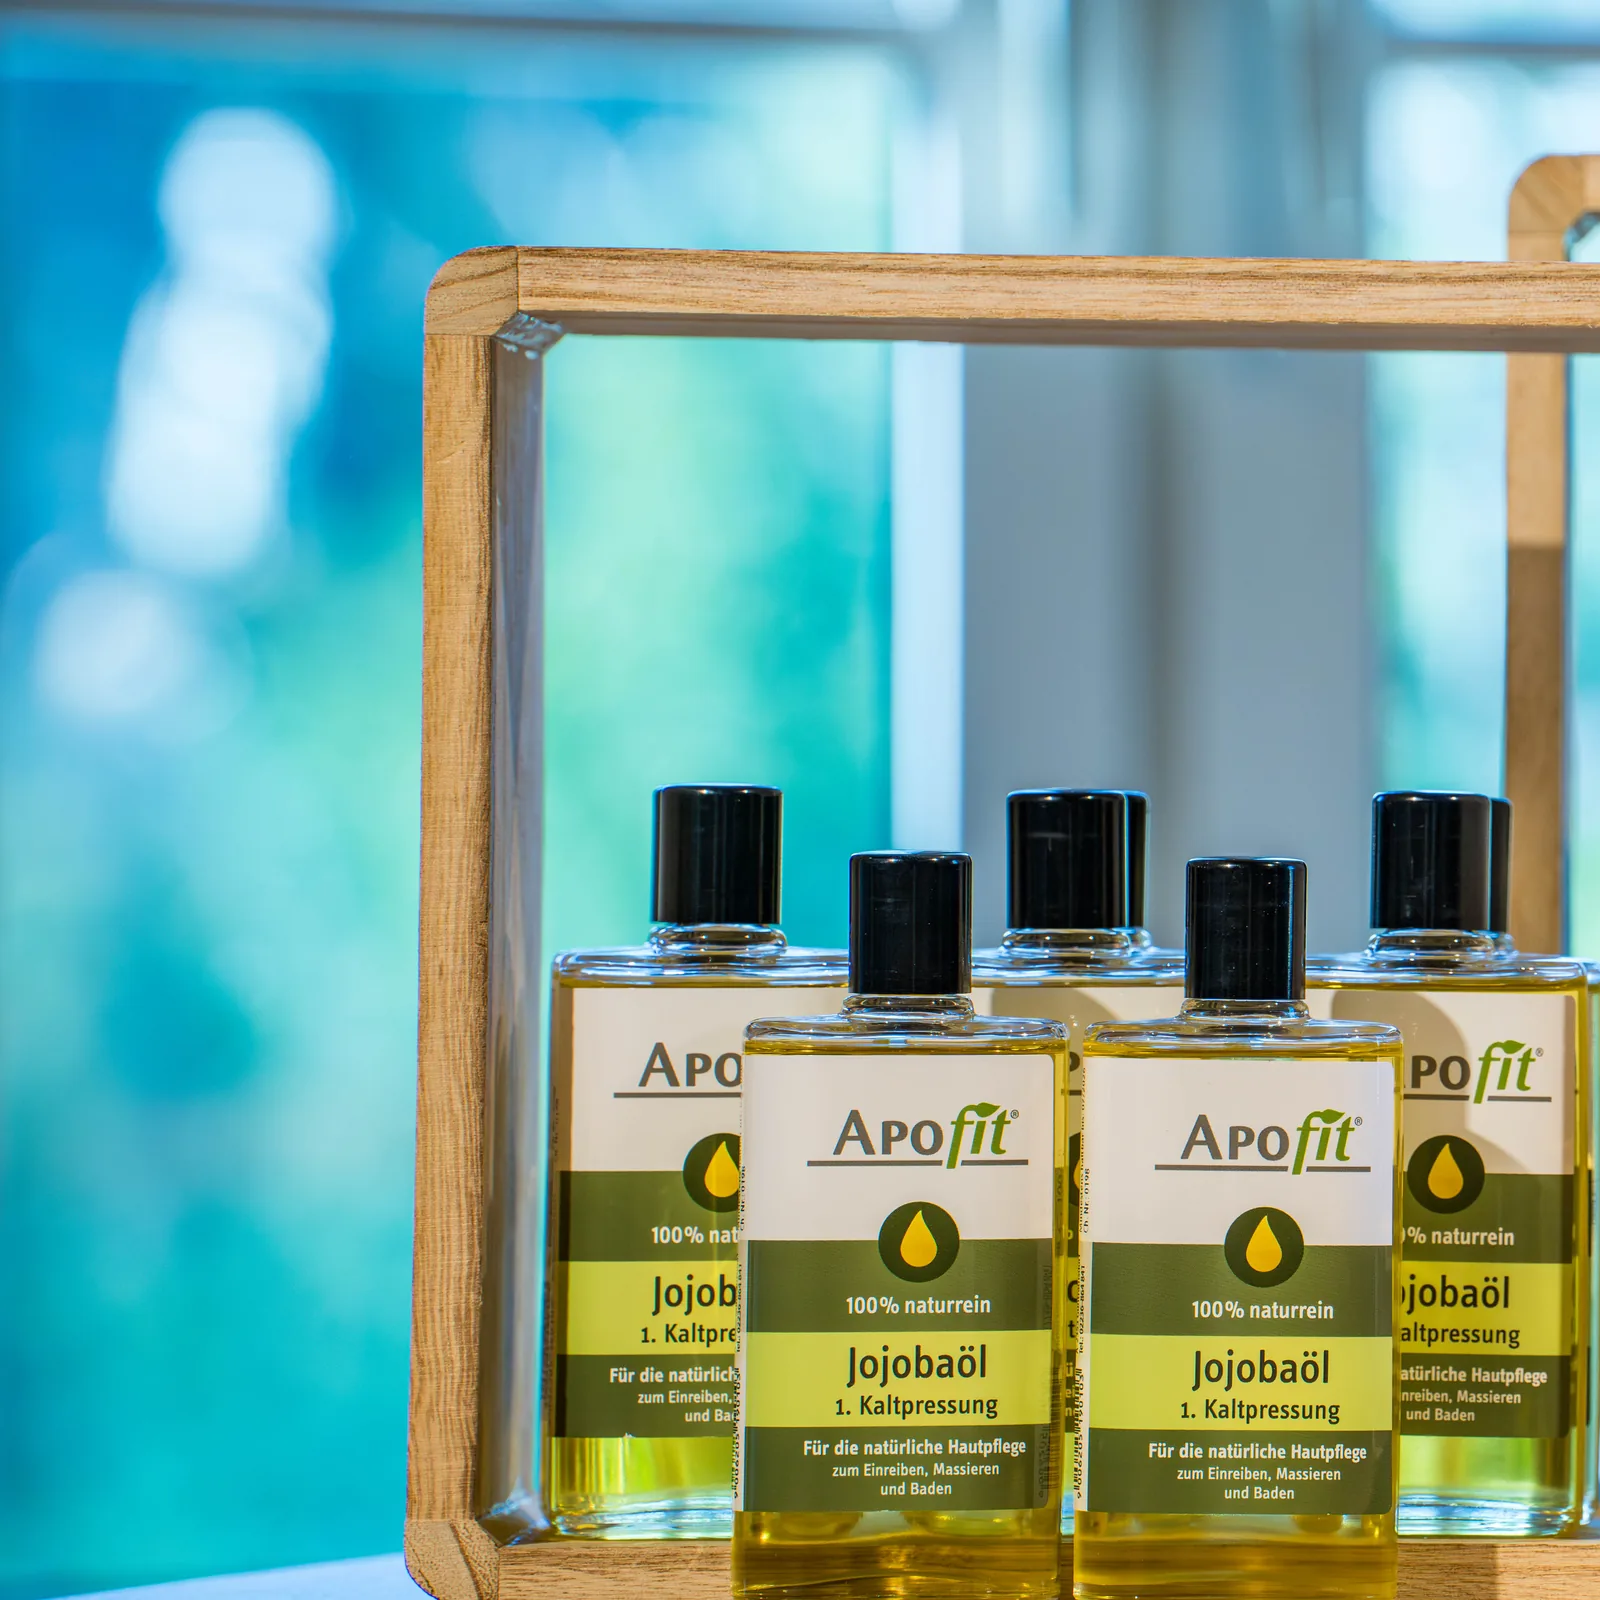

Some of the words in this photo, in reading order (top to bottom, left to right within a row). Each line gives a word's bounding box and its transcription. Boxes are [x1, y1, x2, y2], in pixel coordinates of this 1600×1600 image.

[652, 1226, 704, 1243] 100%
[1432, 1227, 1514, 1245] naturrein
[652, 1274, 737, 1316] Jojob
[1402, 1274, 1509, 1315] jobaöl
[847, 1297, 899, 1314] 100%
[905, 1295, 990, 1313] naturrein
[1193, 1301, 1244, 1318] 100%
[1250, 1301, 1333, 1319] naturrein
[642, 1327, 655, 1343] 1.
[666, 1323, 736, 1347] Kaltpre
[1401, 1323, 1520, 1349] altpressung
[610, 1367, 635, 1382] Für
[640, 1367, 663, 1382] die
[669, 1366, 735, 1382] natürlich
[847, 1344, 986, 1388] Jojobaöl
[1192, 1349, 1328, 1391] Jojobaöl
[1401, 1366, 1466, 1382] atürliche
[1472, 1368, 1547, 1387] Hautpflege
[638, 1394, 664, 1403] zum
[669, 1390, 732, 1404] Einreiben,
[1402, 1389, 1452, 1404] nreiben,
[1457, 1390, 1521, 1403] Massieren
[685, 1409, 709, 1421] und
[836, 1399, 851, 1415] 1.
[861, 1394, 998, 1420] Kaltpressung
[1181, 1402, 1195, 1418] 1.
[1206, 1399, 1340, 1424] Kaltpressung
[1406, 1408, 1430, 1420] und
[1435, 1408, 1474, 1421] Baden
[804, 1440, 829, 1455] Für
[835, 1440, 858, 1455] die
[864, 1439, 942, 1455] natürliche
[949, 1438, 1025, 1457] Hautpflege
[1149, 1443, 1174, 1458] Für
[1179, 1443, 1203, 1458] die
[1209, 1443, 1286, 1458] natürliche
[1292, 1444, 1366, 1463] Hautpflege
[833, 1467, 859, 1476] zum
[864, 1463, 928, 1477] Einreiben,
[934, 1462, 999, 1475] Massieren
[1177, 1470, 1203, 1479] zum
[1209, 1467, 1271, 1481] Einreiben,
[1277, 1467, 1340, 1480] Massieren
[881, 1482, 905, 1495] und
[911, 1481, 951, 1495] Baden
[1225, 1486, 1248, 1499] und
[1254, 1486, 1294, 1499] Baden
